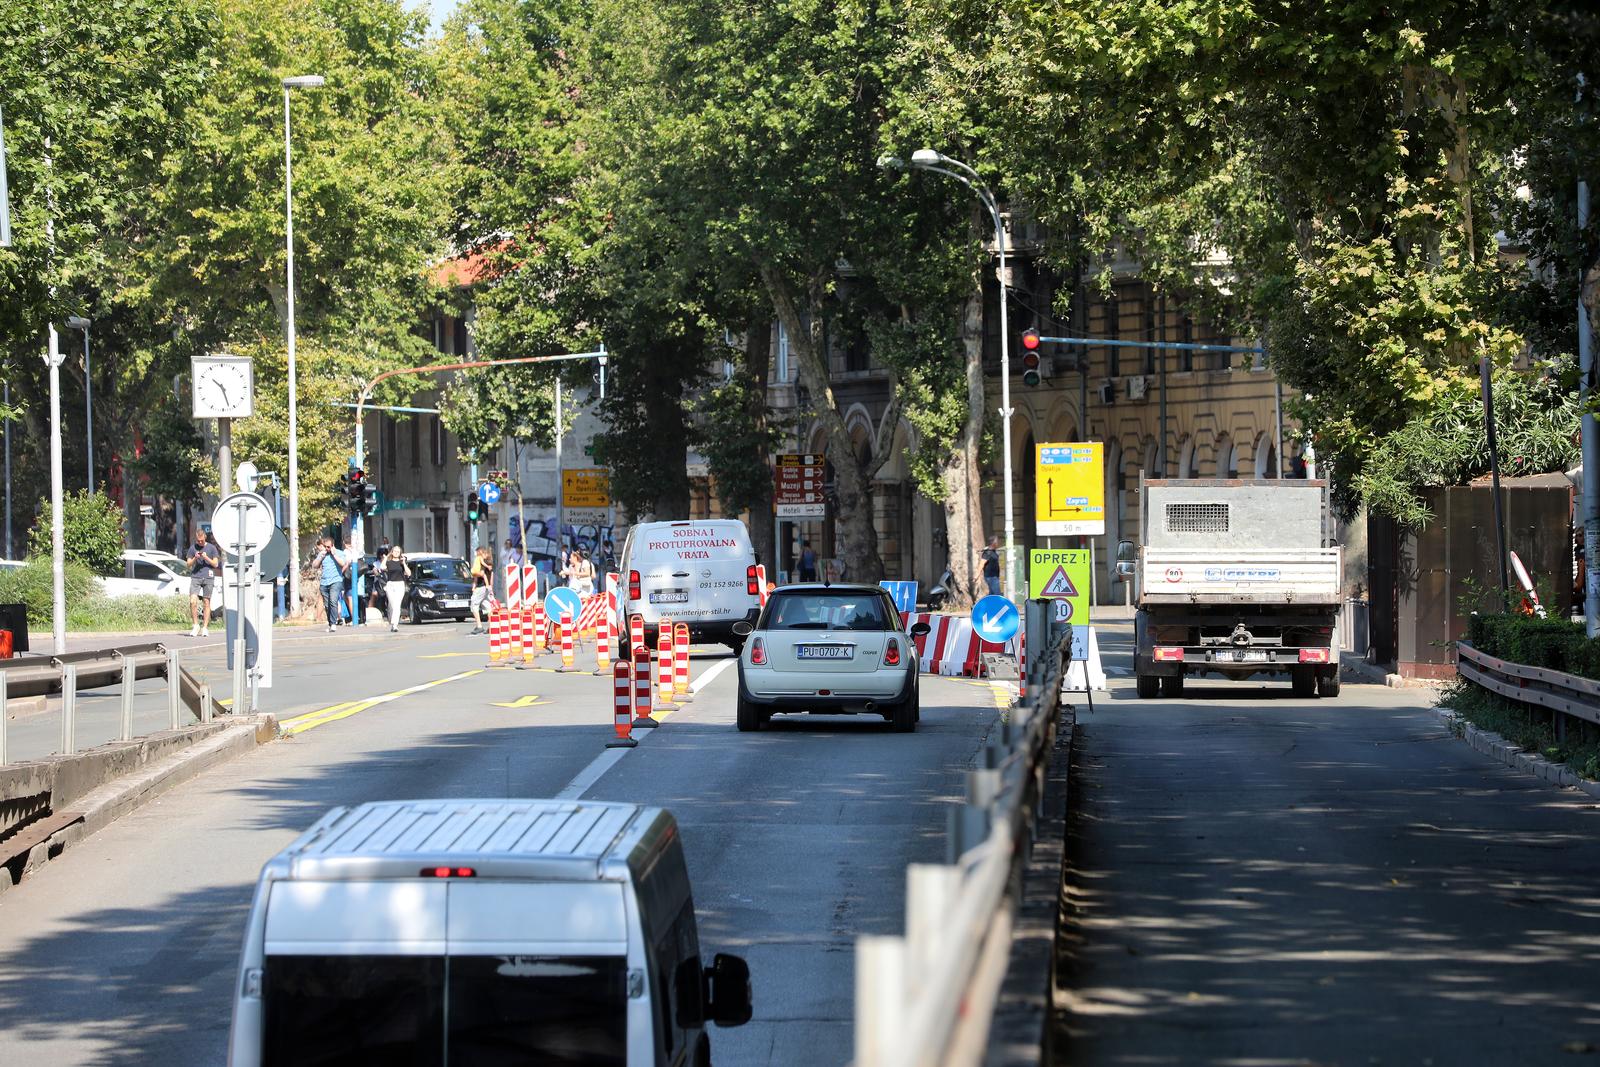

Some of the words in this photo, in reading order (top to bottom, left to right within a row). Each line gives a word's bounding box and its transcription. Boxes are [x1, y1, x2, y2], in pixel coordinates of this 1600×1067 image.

[781, 482, 801, 491] Muzeji
[1064, 524, 1072, 532] 50
[673, 529, 708, 538] SOBNA
[710, 528, 715, 537] I
[649, 539, 736, 550] PROTUPROVALNA
[677, 550, 709, 559] VRATA
[1034, 553, 1077, 564] OPREZ
[728, 580, 744, 588] 9266
[661, 608, 731, 617] www.interijer-stil.hr
[803, 647, 815, 656] PU
